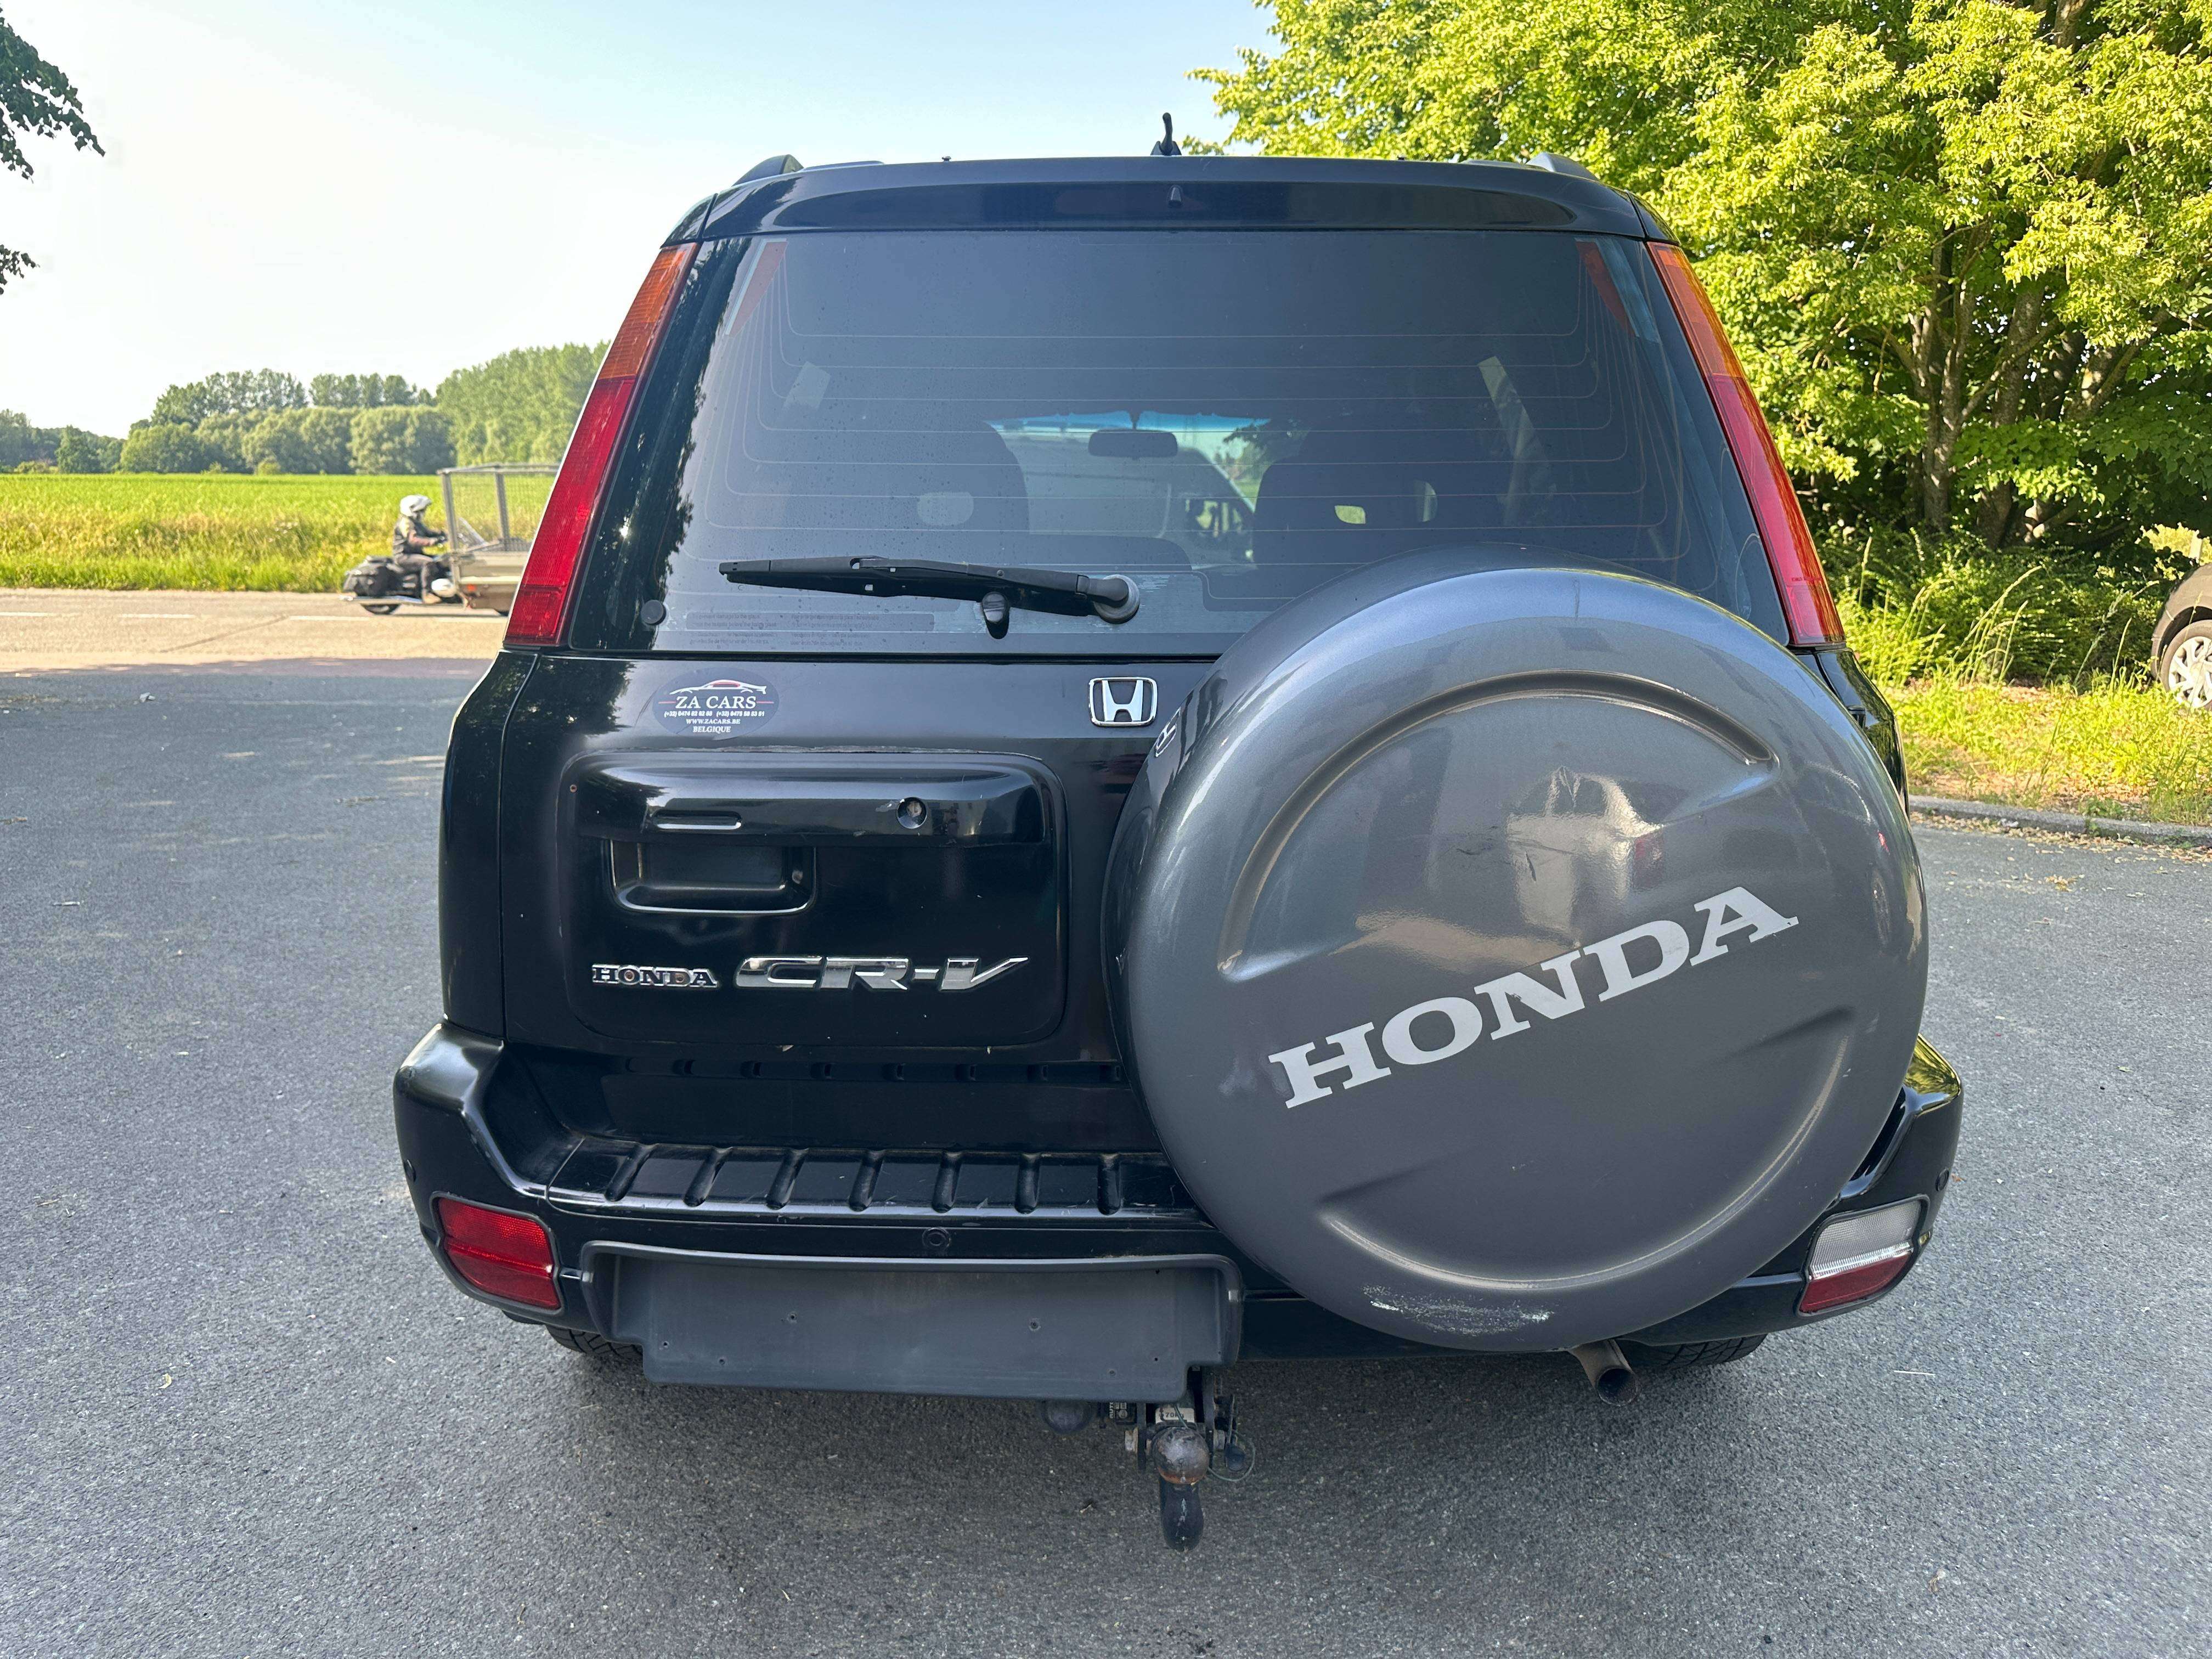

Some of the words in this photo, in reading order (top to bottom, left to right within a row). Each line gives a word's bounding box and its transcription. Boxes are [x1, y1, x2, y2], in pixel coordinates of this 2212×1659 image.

[675, 696, 701, 709] ZA
[706, 696, 757, 709] CARS
[592, 964, 719, 988] HONDA
[736, 956, 1029, 991] CR-V
[1268, 887, 1799, 1109] HONDA
